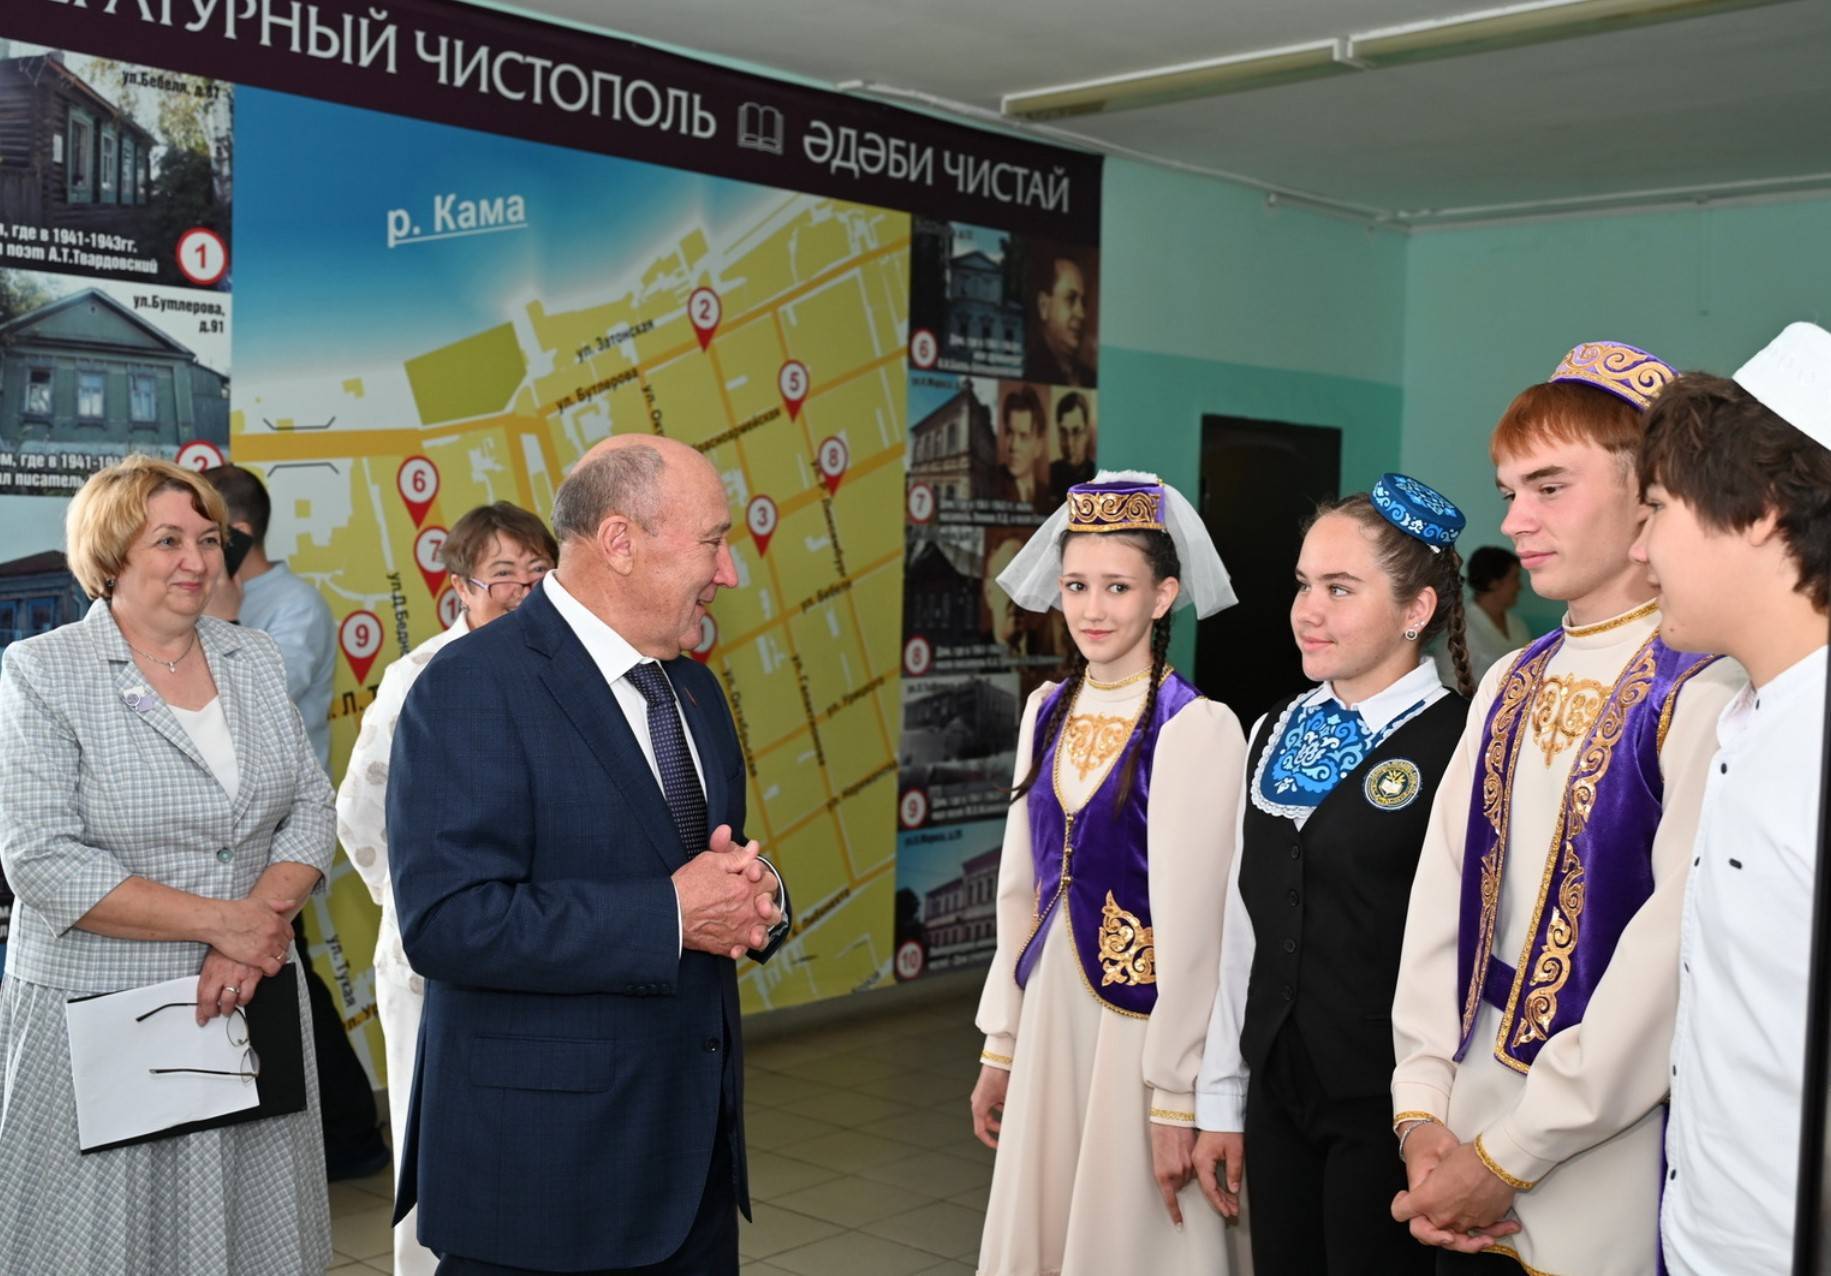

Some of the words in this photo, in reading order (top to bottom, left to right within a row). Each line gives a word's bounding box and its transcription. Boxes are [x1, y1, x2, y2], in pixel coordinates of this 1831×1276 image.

[414, 30, 717, 139] ЧИСТОПОЛЬ
[803, 120, 933, 186] ӘДӘБИ
[943, 150, 1070, 213] ЧИСТАЙ
[387, 208, 421, 248] р.
[434, 193, 526, 232] Кама
[12, 225, 37, 241] где
[40, 228, 49, 242] в
[193, 243, 207, 269] 1
[133, 294, 225, 318] ул.Бутлерова,
[700, 300, 711, 320] 2
[199, 319, 224, 334] д.91
[789, 372, 800, 392] 5
[20, 454, 45, 469] где
[48, 455, 57, 468] в
[828, 449, 838, 467] 8
[413, 470, 426, 493] 6
[757, 507, 767, 526] 3
[429, 539, 442, 562] 7
[355, 624, 370, 648] 9
